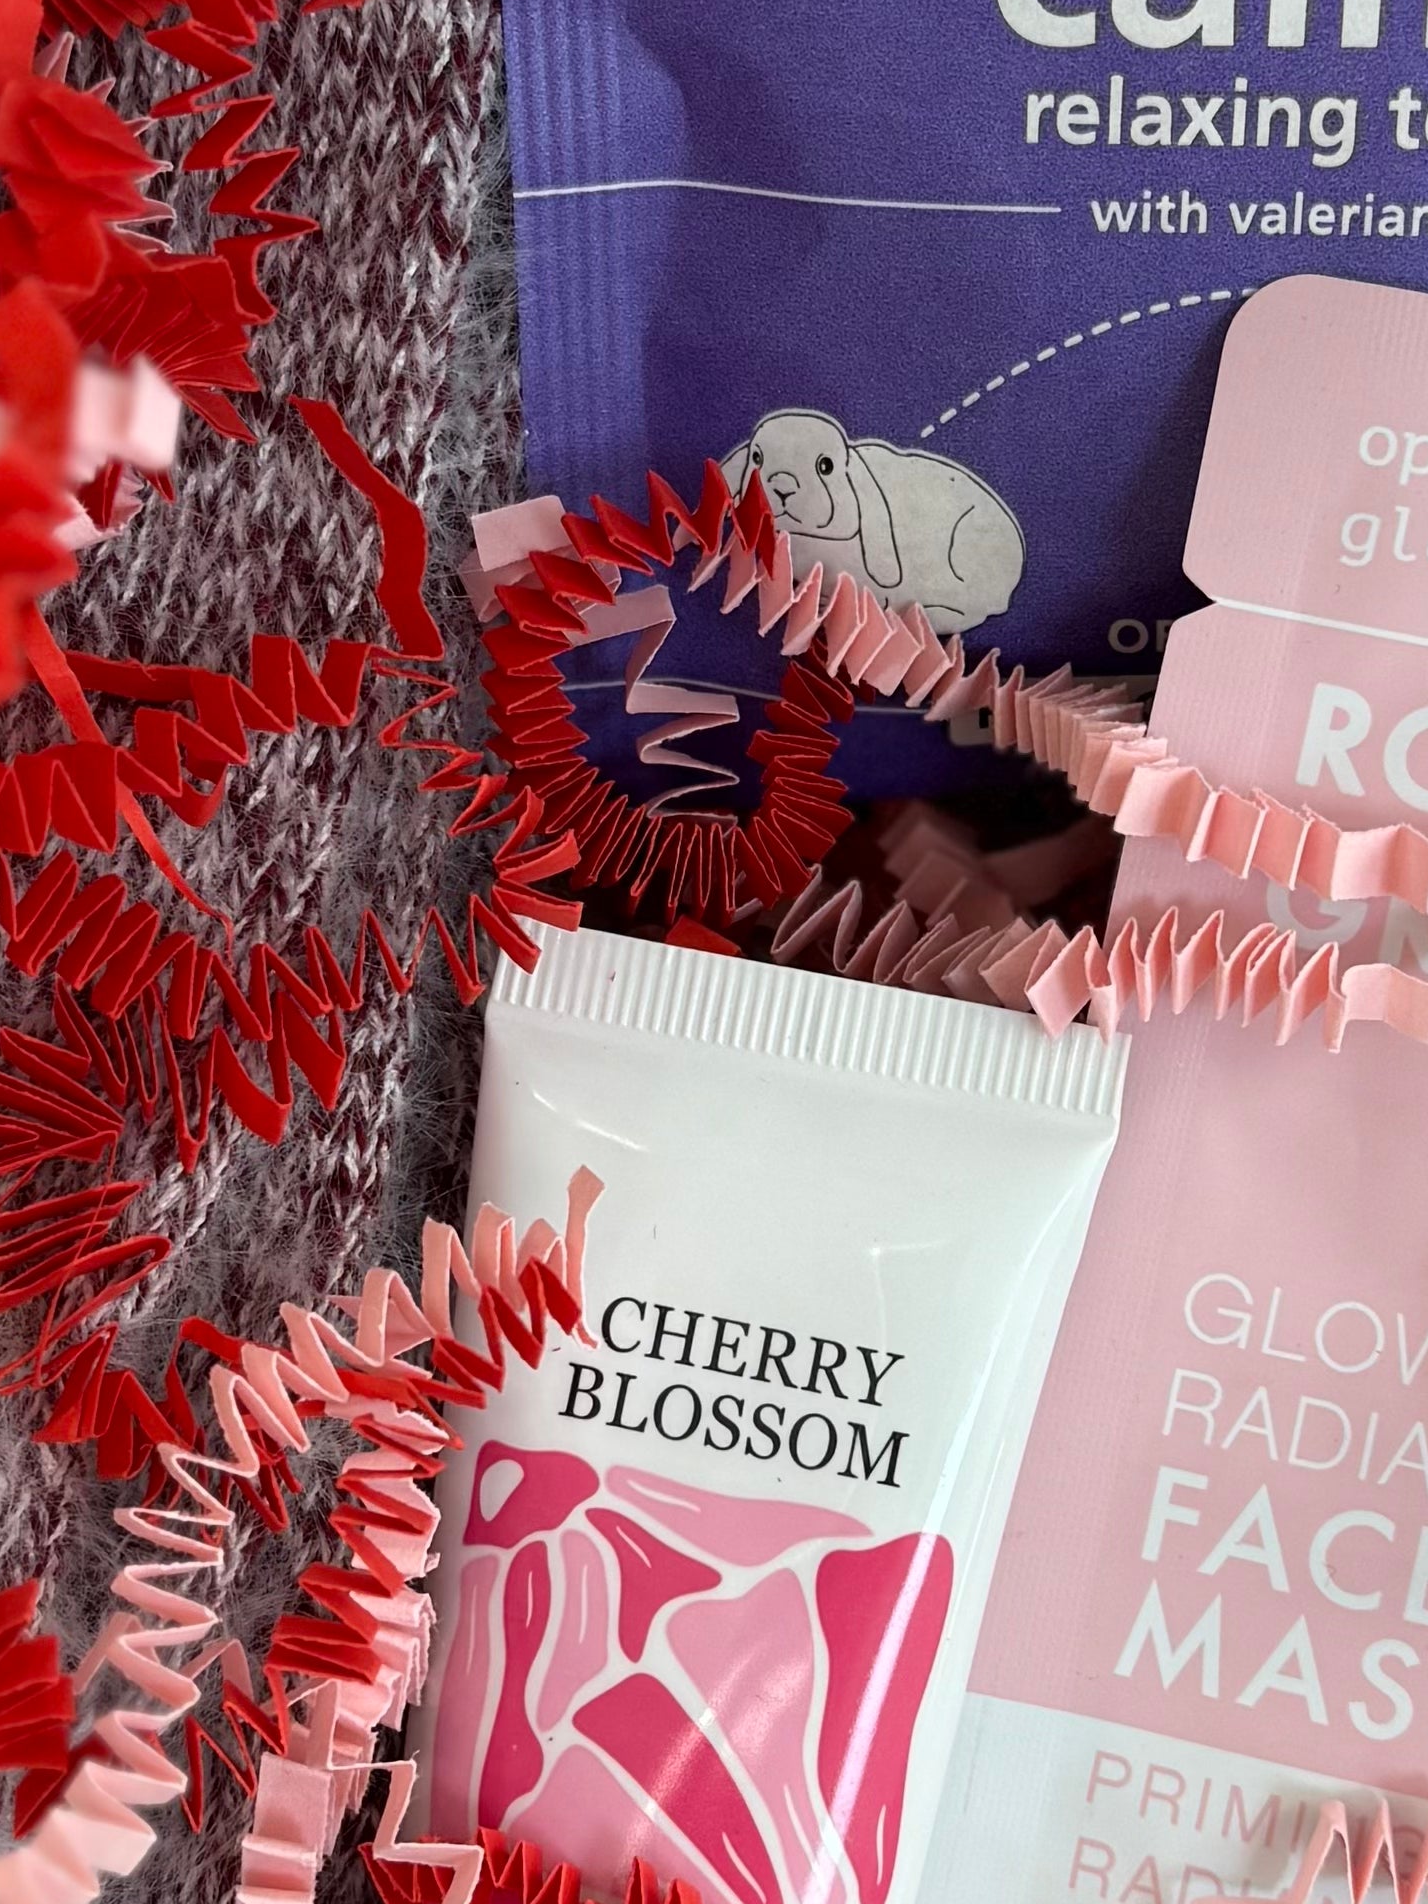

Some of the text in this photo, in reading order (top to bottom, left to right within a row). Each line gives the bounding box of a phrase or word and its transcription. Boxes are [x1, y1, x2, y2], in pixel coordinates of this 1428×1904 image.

[1025, 76, 1358, 168] relaxing
[1091, 190, 1208, 238] with
[601, 1296, 905, 1407] CHERRY
[558, 1361, 911, 1488] BLOSSOM
